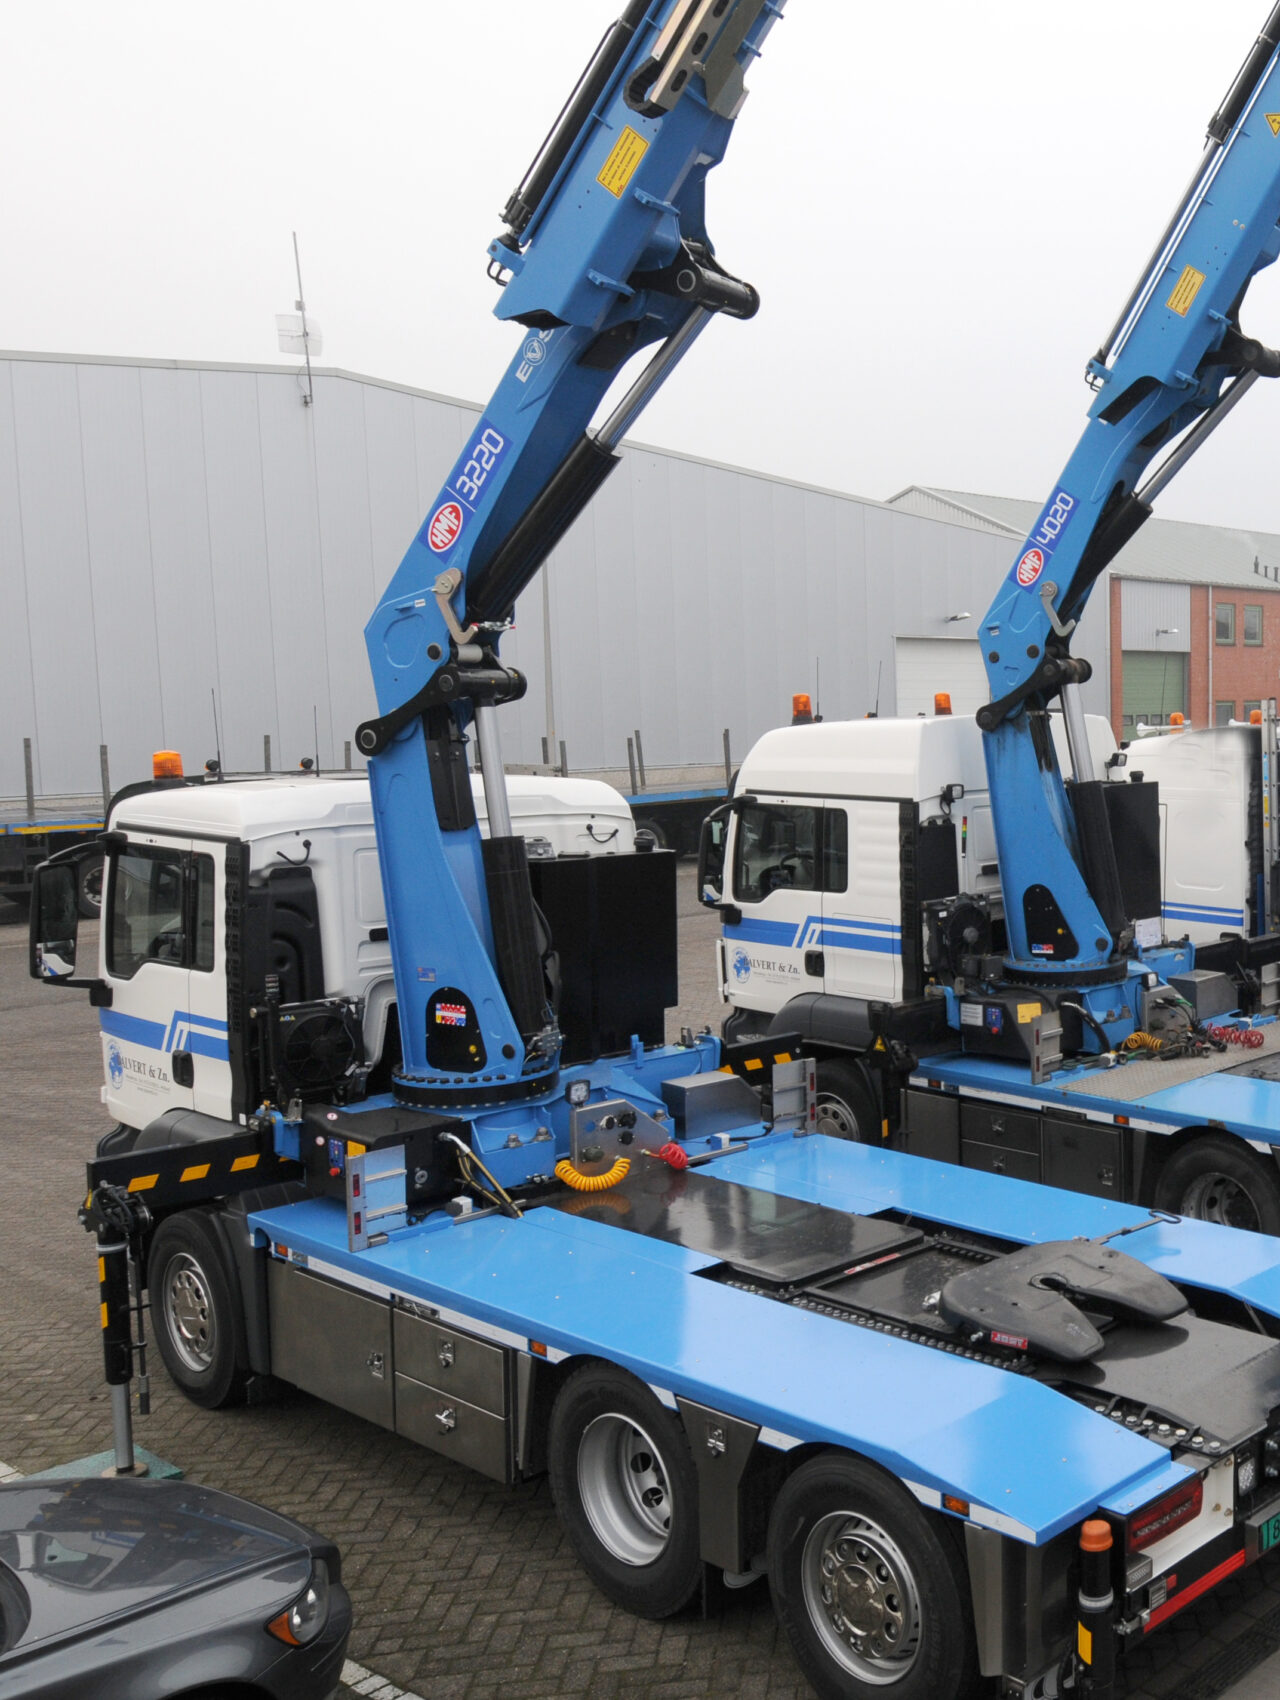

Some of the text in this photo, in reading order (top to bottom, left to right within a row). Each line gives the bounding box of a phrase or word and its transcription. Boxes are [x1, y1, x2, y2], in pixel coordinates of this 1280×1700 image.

[429, 428, 504, 550] HMF 3220
[1018, 492, 1074, 585] HMF 4020
[778, 962, 786, 972] &
[148, 1064, 156, 1078] &
